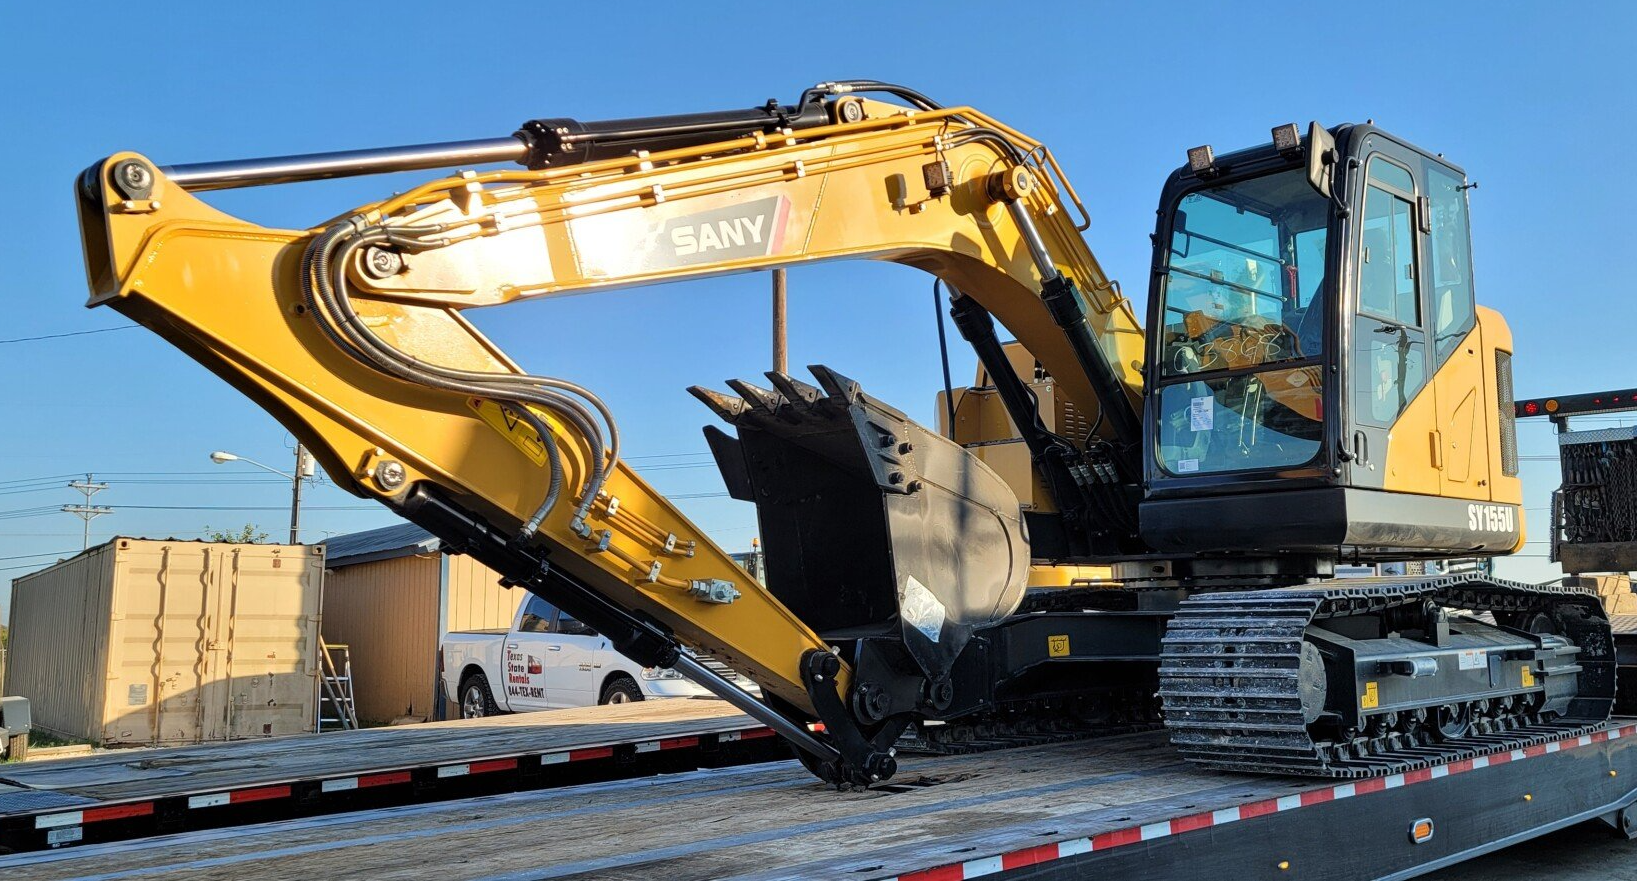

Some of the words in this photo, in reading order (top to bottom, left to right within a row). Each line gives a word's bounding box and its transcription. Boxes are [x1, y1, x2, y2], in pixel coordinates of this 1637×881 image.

[671, 214, 765, 256] SANY
[1468, 503, 1514, 533] SY155U
[507, 650, 523, 661] Texas
[508, 662, 524, 672] State
[509, 673, 530, 684] Rentals
[508, 686, 545, 698] 844-TEX-RENT
